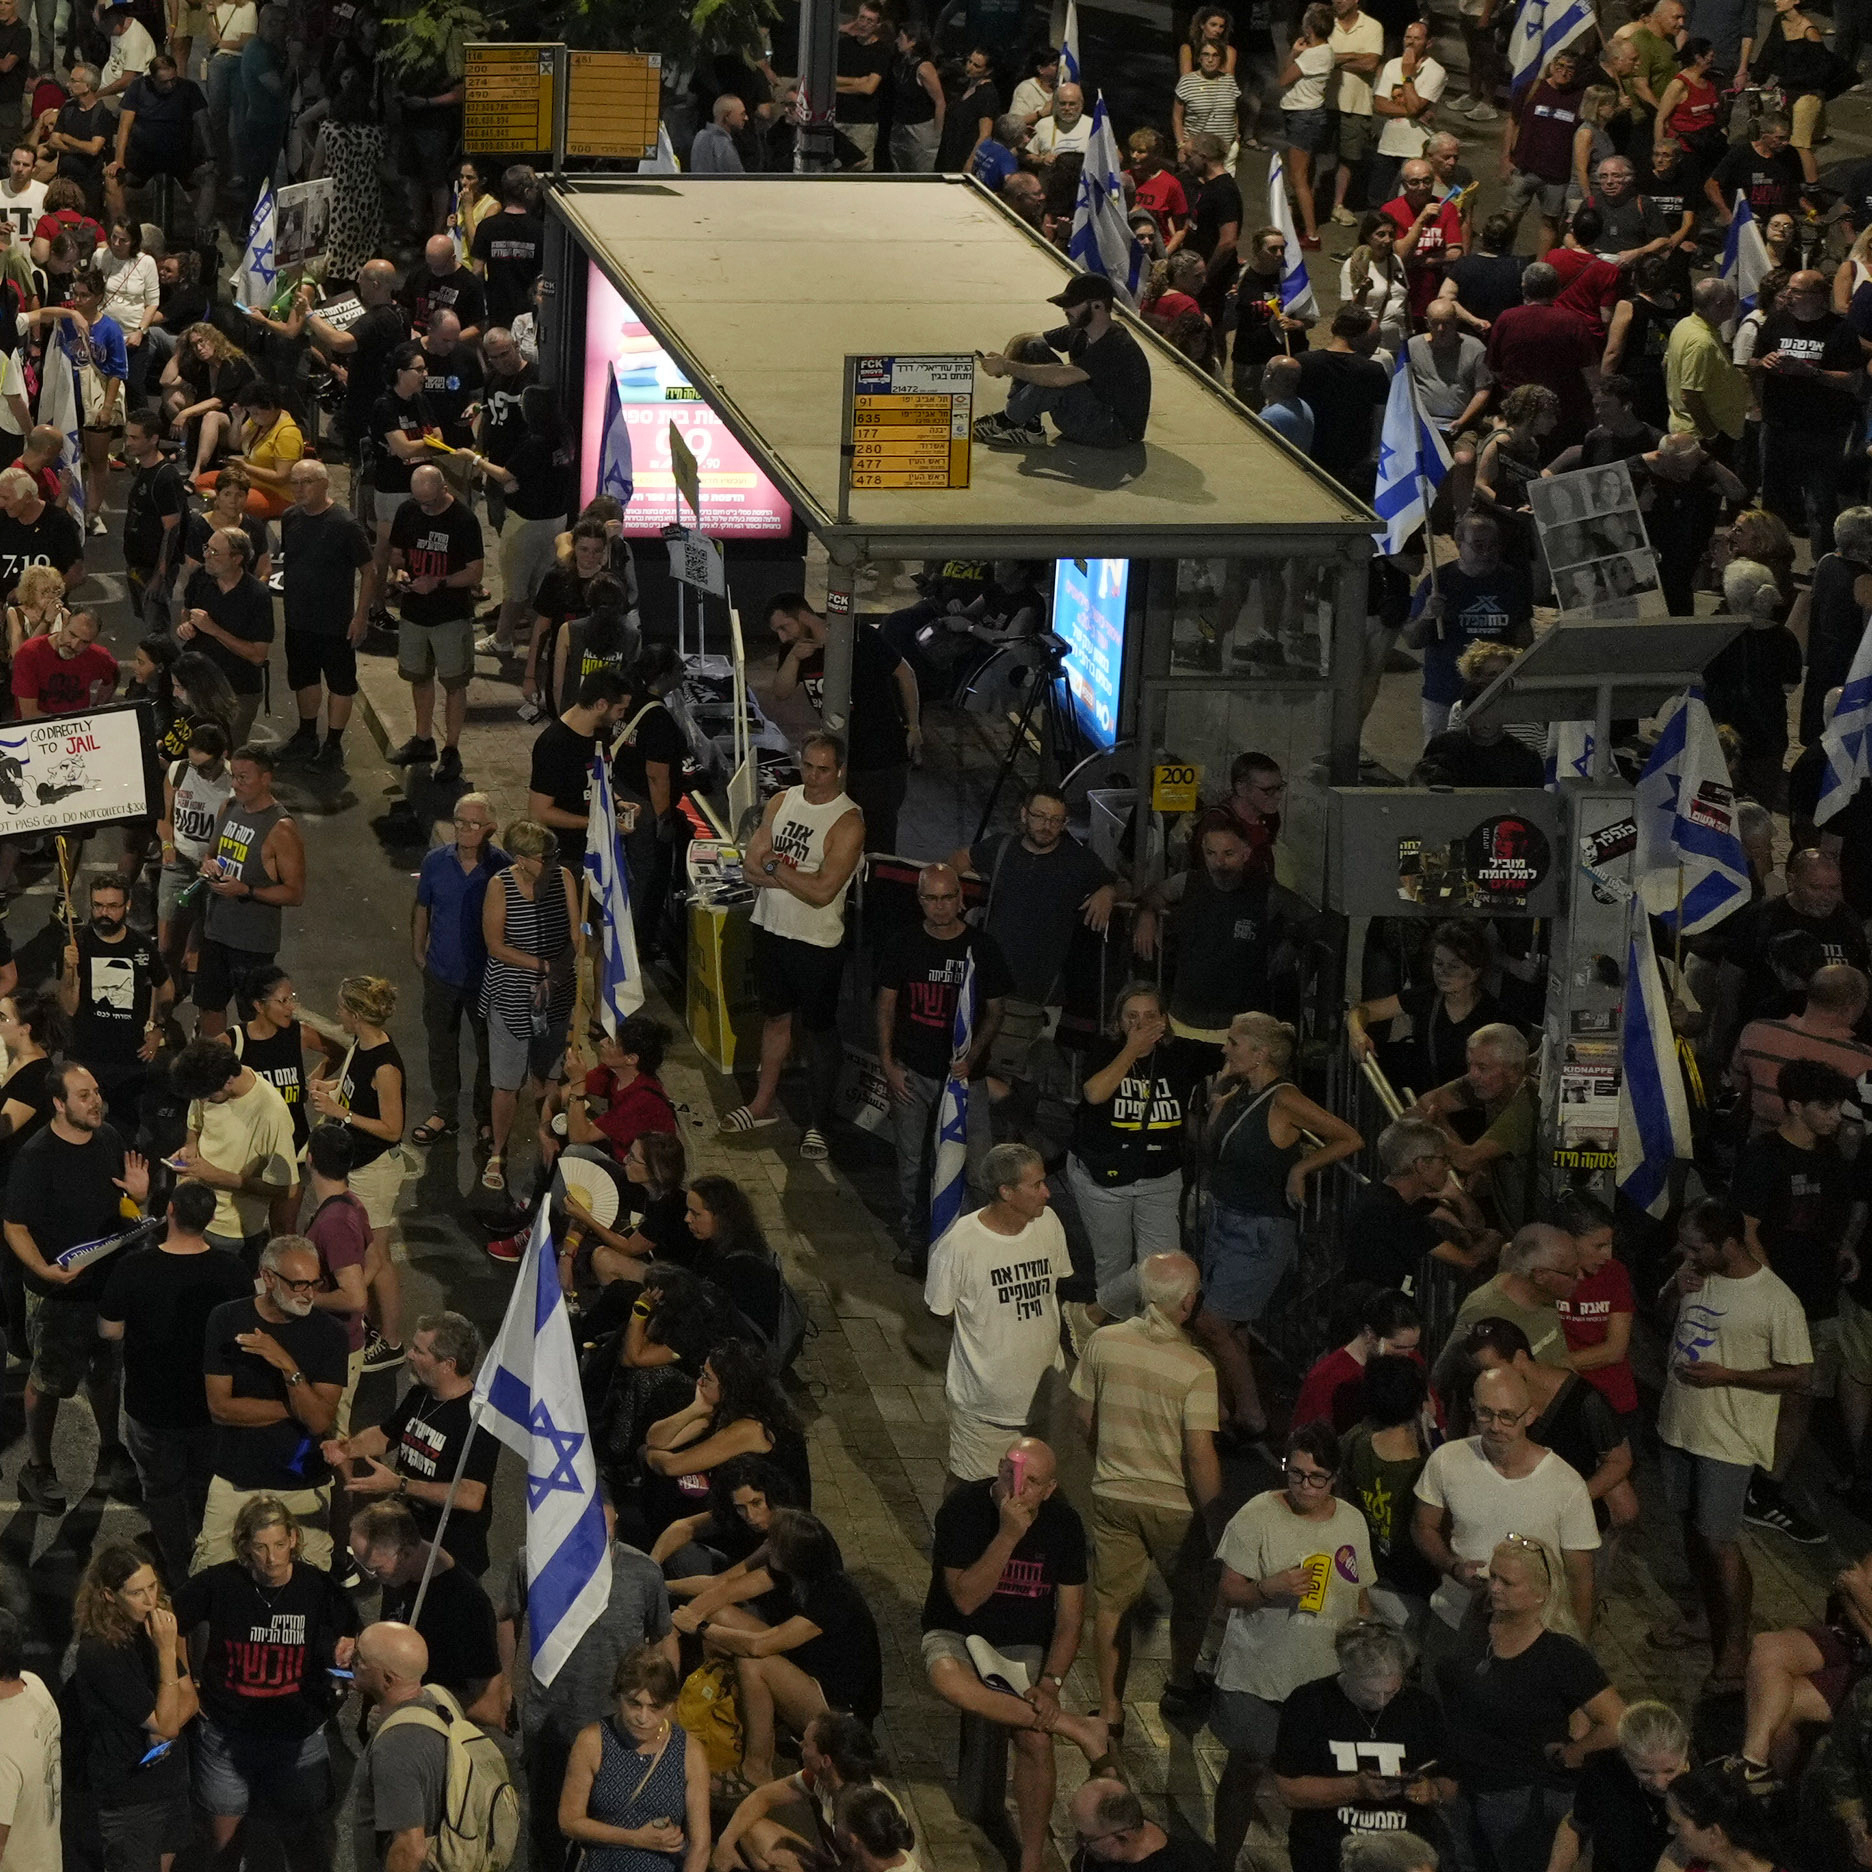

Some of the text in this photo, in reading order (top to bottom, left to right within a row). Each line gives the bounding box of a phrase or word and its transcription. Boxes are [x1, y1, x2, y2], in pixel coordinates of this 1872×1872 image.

[860, 359, 884, 369] FCK
[892, 385, 919, 394] 21472
[859, 397, 873, 408] 91
[857, 414, 881, 424] 635
[858, 429, 880, 439] 177
[858, 445, 882, 454] 280
[857, 459, 881, 470] 477
[857, 475, 882, 485] 478
[828, 592, 849, 606] FCK
[30, 719, 94, 743] GO DIRECTLY
[38, 734, 101, 755] TO JAIL
[1160, 767, 1195, 785] 200
[15, 818, 41, 832] PASS
[43, 814, 58, 827] GO
[62, 812, 79, 825] DO
[79, 808, 98, 820] NOT
[96, 805, 127, 819] COLLECT
[126, 802, 147, 815] $200
[990, 1268, 1007, 1285] את
[271, 1614, 306, 1629] מחזירים
[225, 1641, 306, 1686] עכשיו
[1328, 1739, 1406, 1777] די
